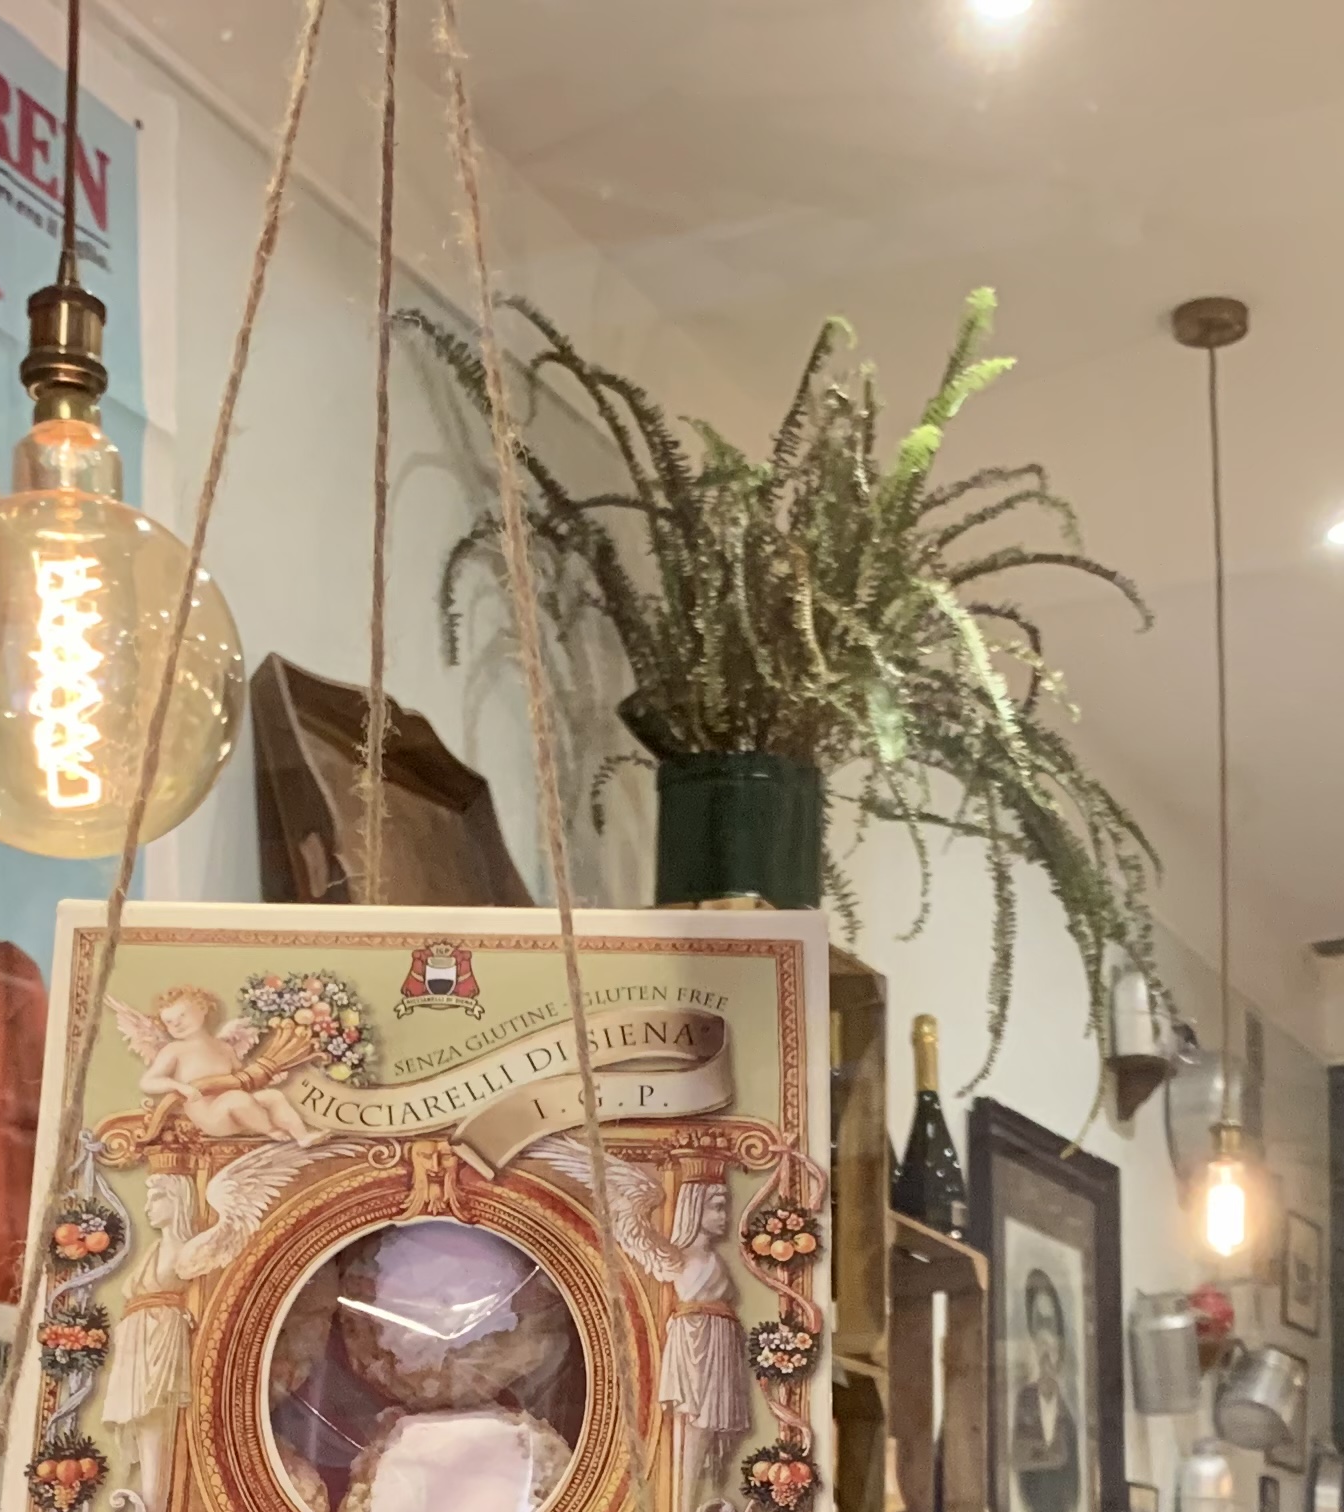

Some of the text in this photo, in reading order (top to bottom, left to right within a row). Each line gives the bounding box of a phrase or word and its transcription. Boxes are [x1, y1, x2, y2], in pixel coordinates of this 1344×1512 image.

[394, 985, 730, 1077] SENZA GLUTINE GLUTEN FREE
[525, 1040, 570, 1073] DI
